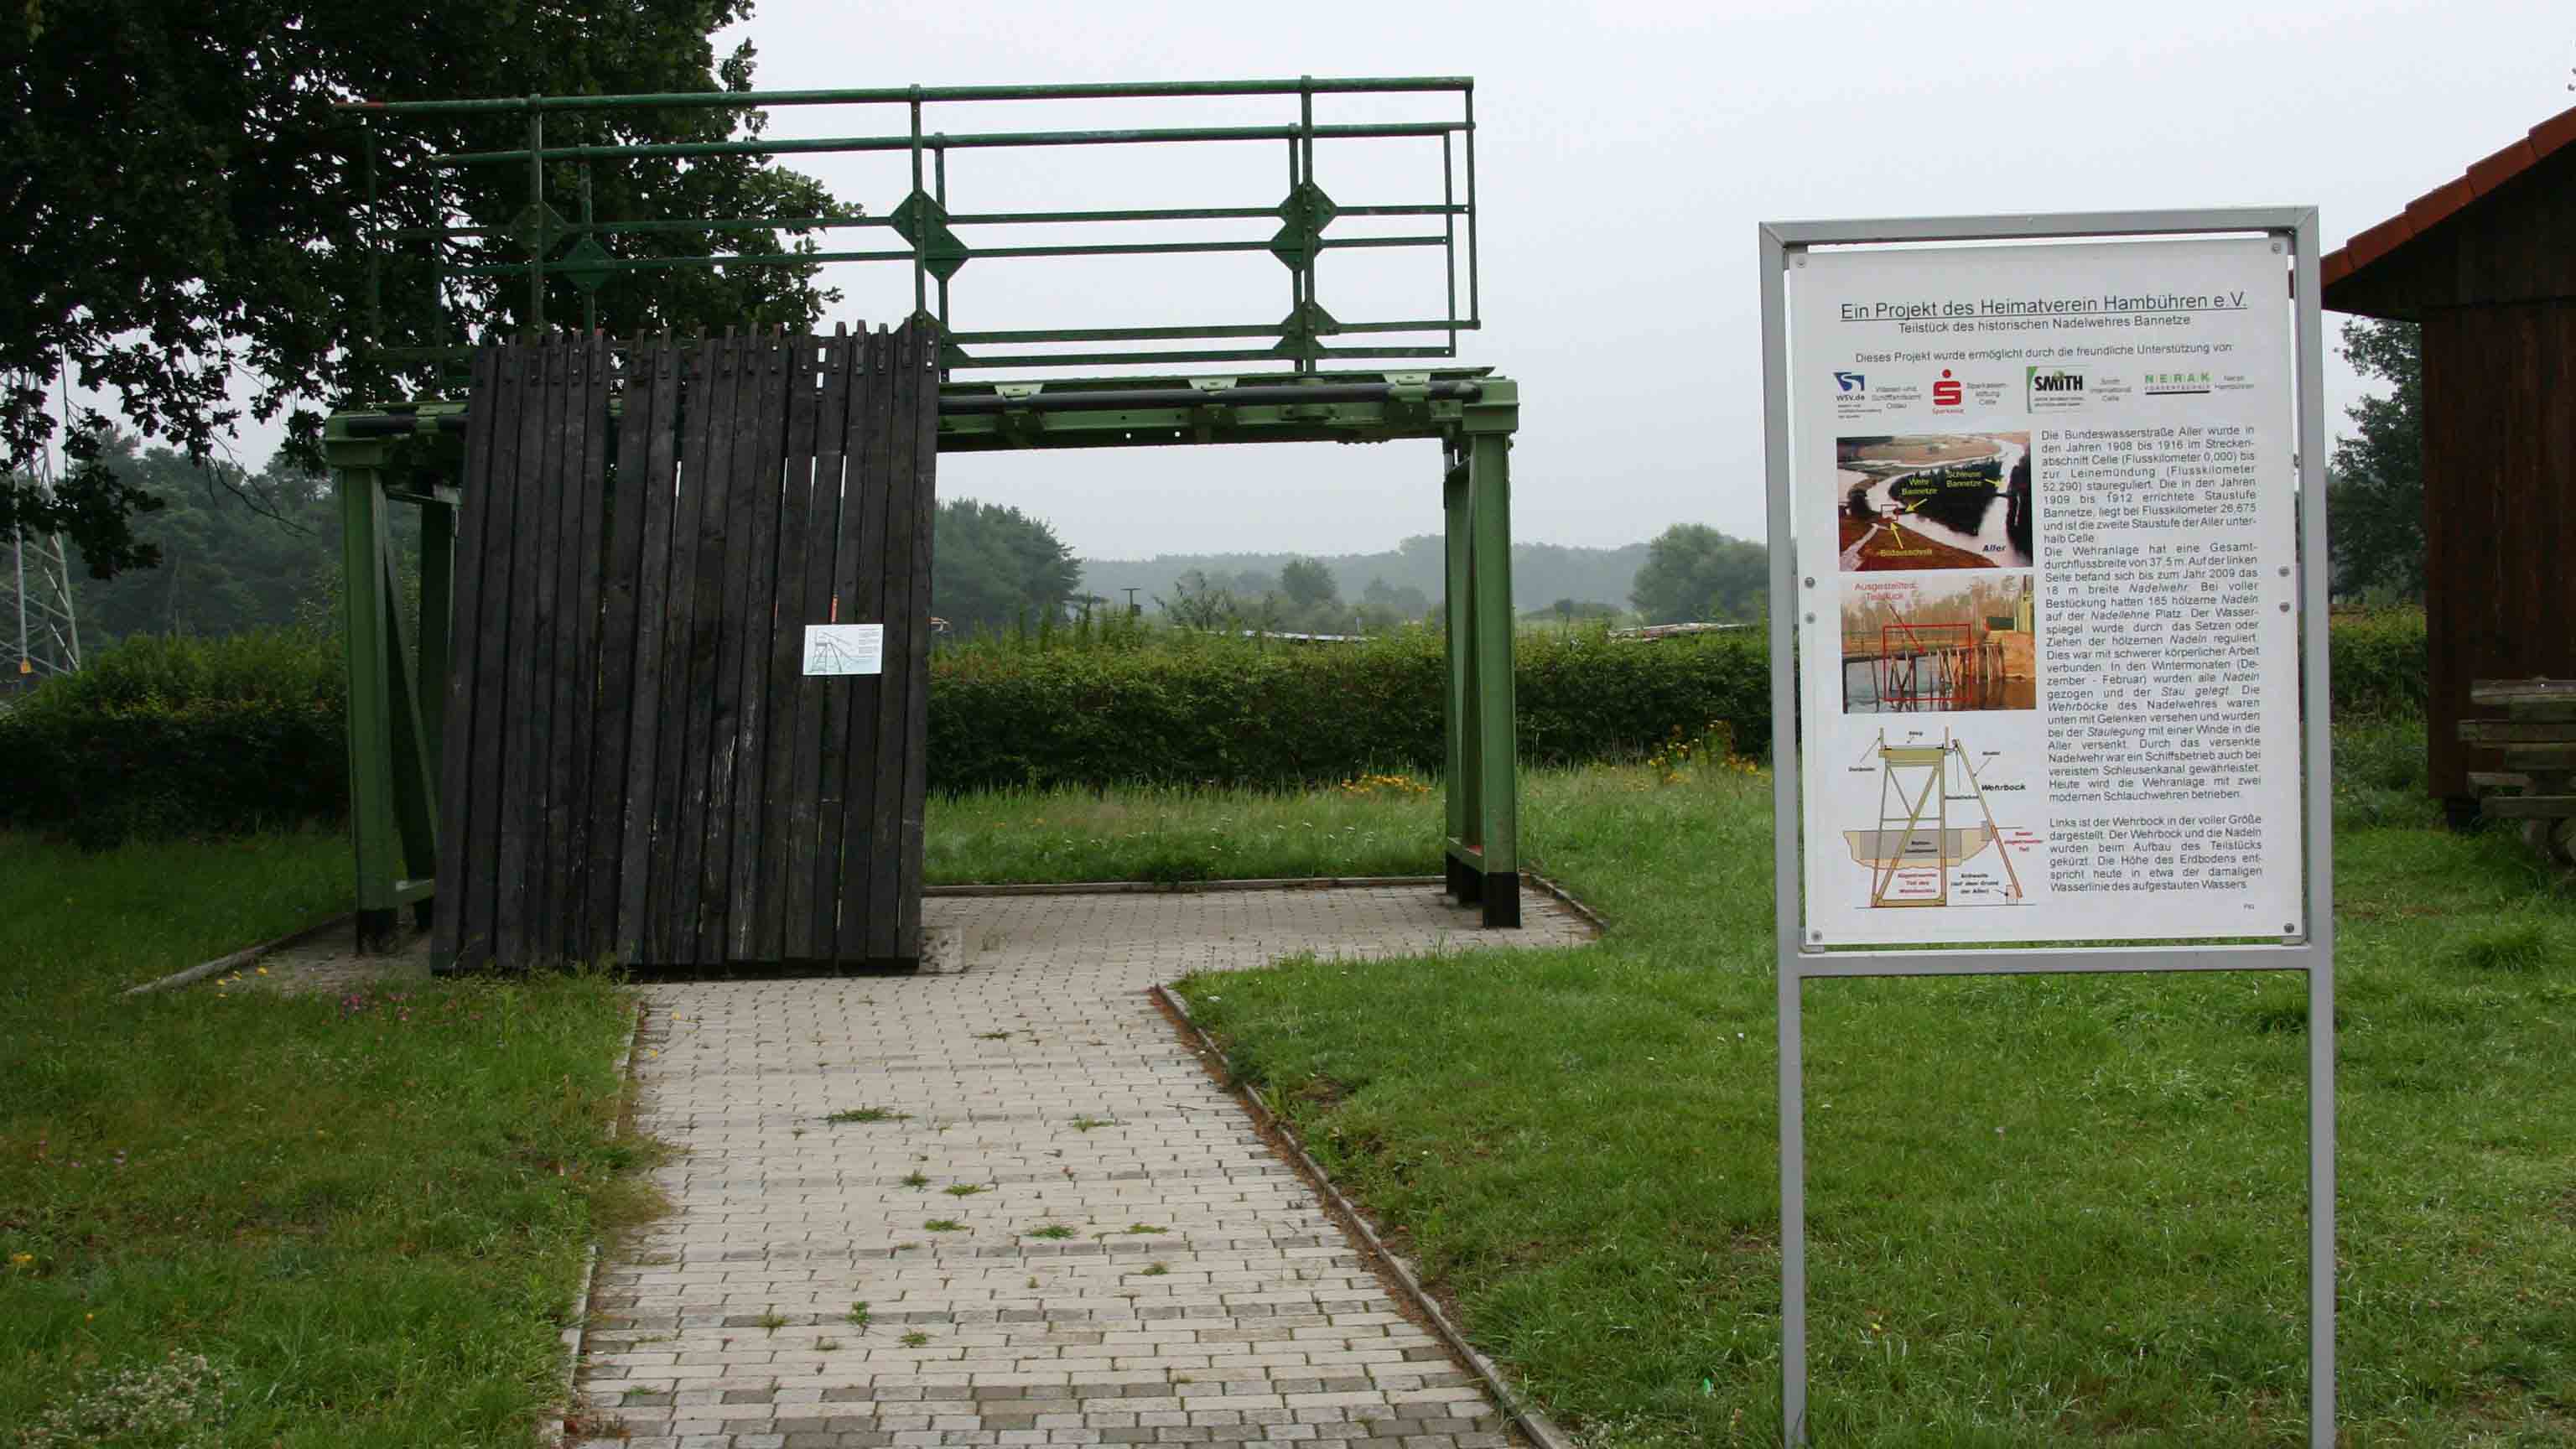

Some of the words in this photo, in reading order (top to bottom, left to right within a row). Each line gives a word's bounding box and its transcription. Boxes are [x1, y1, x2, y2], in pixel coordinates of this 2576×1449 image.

[1841, 303, 1869, 319] Ein
[1875, 302, 1937, 319] Projekt
[1942, 300, 1974, 316] des
[1981, 297, 2096, 315] Heimatverein
[2103, 293, 2207, 310] Hambühren
[2214, 292, 2247, 308] e.V.
[1898, 322, 1949, 334] Teilstück
[1952, 322, 1974, 332] des
[1979, 320, 2049, 331] historischen
[2053, 317, 2130, 329] Nadelwehres
[2134, 315, 2190, 327] Bannetze
[1856, 353, 1892, 362] Dieses
[1894, 351, 1930, 363] Projekt
[1934, 351, 1966, 361] wurde
[1969, 349, 2023, 361] ermöglicht
[2026, 347, 2054, 357] durch
[2058, 346, 2074, 356] die
[2076, 345, 2133, 356] freundliche
[2137, 344, 2209, 356] Unterstützung
[2034, 375, 2083, 392] SMITH
[2064, 428, 2174, 439] Bundeswasserstraße
[2178, 427, 2201, 437] Aller
[2207, 426, 2240, 436] wurde
[2065, 441, 2101, 451] Jahren
[2107, 441, 2132, 450] 1908
[2158, 439, 2184, 449] 1916
[2205, 438, 2256, 448] Strecken-
[2042, 454, 2088, 465] abschnitt
[2091, 454, 2118, 464] Celle
[2122, 452, 2201, 465] (Flusskilometer
[2240, 451, 2254, 460] bis
[2070, 466, 2155, 480] Leinemündung
[2166, 464, 2254, 477] (Flusskilometer
[2220, 477, 2255, 487] Jahren
[2106, 492, 2132, 502] 1912
[2142, 491, 2194, 501] errichtete
[2205, 490, 2256, 500] Staustufe
[2098, 506, 2121, 518] liegt
[2142, 504, 2217, 515] Flusskilometer
[2044, 520, 2063, 530] und
[2096, 519, 2130, 528] zweite
[2131, 517, 2180, 528] Staustufe
[2199, 517, 2224, 527] Aller
[2225, 516, 2257, 526] unter-
[2044, 533, 2066, 543] halb
[2072, 545, 2139, 558] Wehranlage
[2175, 543, 2199, 553] eine
[2209, 543, 2257, 553] Gesamt-
[2044, 558, 2127, 569] durchflussbreite
[2188, 556, 2206, 565] Auf
[2226, 554, 2257, 564] linken
[2045, 572, 2071, 581] Seite
[2075, 571, 2111, 580] befand
[2114, 570, 2135, 579] sich
[2182, 569, 2205, 579] Jahr
[2209, 568, 2235, 578] 2009
[2087, 584, 2119, 594] breite
[2045, 597, 2106, 610] Bestückung
[2110, 596, 2143, 606] hatten
[2148, 595, 2167, 605] 185
[2221, 594, 2257, 604] Nadeln
[2090, 610, 2150, 620] Nadellehne
[2215, 607, 2258, 617] Wasser-
[2046, 624, 2083, 636] spiegel
[2091, 623, 2124, 632] wurde
[2132, 622, 2163, 631] durch
[2194, 621, 2231, 631] Setzen
[2234, 620, 2258, 630] oder
[2046, 636, 2081, 647] Ziehen
[2169, 634, 2207, 644] Nadeln
[2046, 650, 2070, 659] Dies
[2095, 649, 2111, 658] mit
[2114, 648, 2161, 658] schwerer
[2227, 646, 2258, 656] Arbeit
[2151, 659, 2231, 670] Wintermonaten
[2236, 659, 2259, 670] (De-
[2046, 676, 2086, 685] zember
[2153, 673, 2192, 683] wurden
[2197, 673, 2216, 683] alle
[2222, 672, 2259, 682] Nadeln
[2047, 690, 2093, 700] gezogen
[2160, 686, 2185, 696] Stau
[2048, 701, 2108, 711] Wehrböcke
[2147, 699, 2217, 709] Nadelwehres
[2048, 714, 2076, 724] unten
[2079, 714, 2095, 724] mit
[2096, 713, 2147, 723] Gelenken
[2149, 712, 2197, 722] versehen
[2220, 711, 2259, 720] wurden
[2086, 726, 2146, 738] Staulegung
[2166, 724, 2194, 735] einer
[2195, 724, 2230, 734] Winde
[2048, 740, 2072, 750] Aller
[2139, 739, 2171, 748] Durch
[2179, 738, 2200, 747] das
[2209, 737, 2260, 747] versenkte
[2049, 752, 2104, 762] Nadelwehr
[2217, 750, 2243, 760] auch
[2049, 766, 2099, 776] vereistem
[2102, 765, 2185, 775] Schleusenkanal
[2049, 779, 2080, 788] Heute
[2087, 778, 2110, 787] wird
[2142, 776, 2205, 789] Wehranlage
[2237, 776, 2260, 785] zwei
[2049, 791, 2101, 801] modernen
[2103, 789, 2189, 800] Schlauchwehren
[2049, 818, 2076, 828] Links
[2078, 818, 2090, 827] ist
[2111, 817, 2164, 826] Wehrbock
[2228, 815, 2261, 824] Größe
[2129, 828, 2182, 839] Wehrbock
[2225, 827, 2261, 837] Nadeln
[2049, 844, 2088, 853] wurden
[2098, 843, 2124, 852] beim
[2132, 842, 2171, 852] Aufbau
[2211, 840, 2261, 850] Teilstücks
[2097, 855, 2115, 865] Die
[2120, 855, 2148, 865] Höhe
[2179, 854, 2236, 864] Erdbodens
[2241, 853, 2262, 862] ent-
[2050, 869, 2084, 880] spricht
[2092, 868, 2122, 878] heute
[2148, 867, 2174, 877] etwa
[2208, 865, 2262, 878] damaligen
[2132, 880, 2199, 892] aufgestauten
